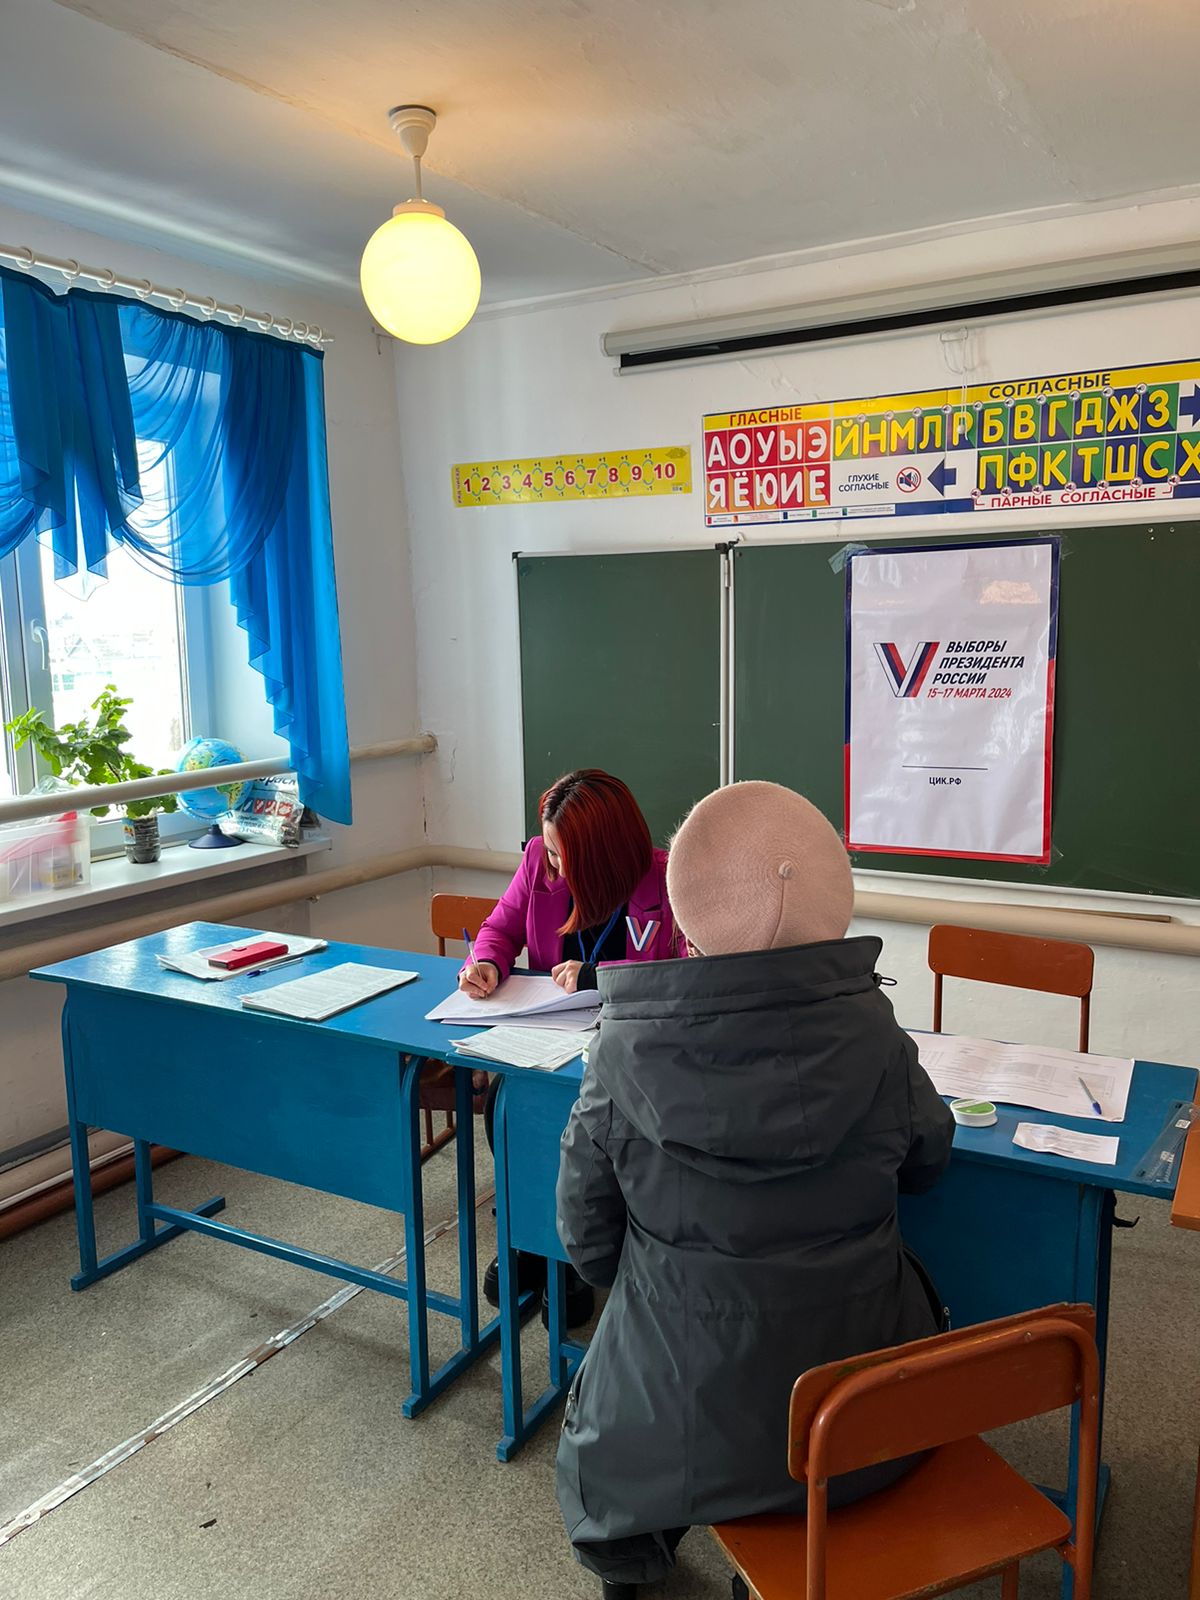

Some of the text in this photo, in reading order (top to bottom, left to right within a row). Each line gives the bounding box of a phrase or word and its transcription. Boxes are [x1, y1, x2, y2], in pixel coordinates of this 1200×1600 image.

[989, 373, 1111, 399] СОГЛАСНЫЕ
[730, 407, 802, 427] ГЛАСНЫЕ
[464, 463, 675, 492] 1 2 3 4 5 6 7 8 9 10
[847, 473, 879, 483] ГЛУХИЕ
[838, 481, 889, 493] СОГЛАСНЫЕ
[991, 487, 1156, 508] ПАРНЫЕ СОГЛАСНЫЕ
[946, 640, 1007, 653] ВЫБОРЫ
[939, 656, 1025, 670] ПРЕЗИДЕНТА
[932, 672, 987, 685] РОССИИ
[954, 688, 986, 698] МАРТА
[987, 687, 1012, 699] 2024
[929, 776, 962, 786] ЦИК.РФ
